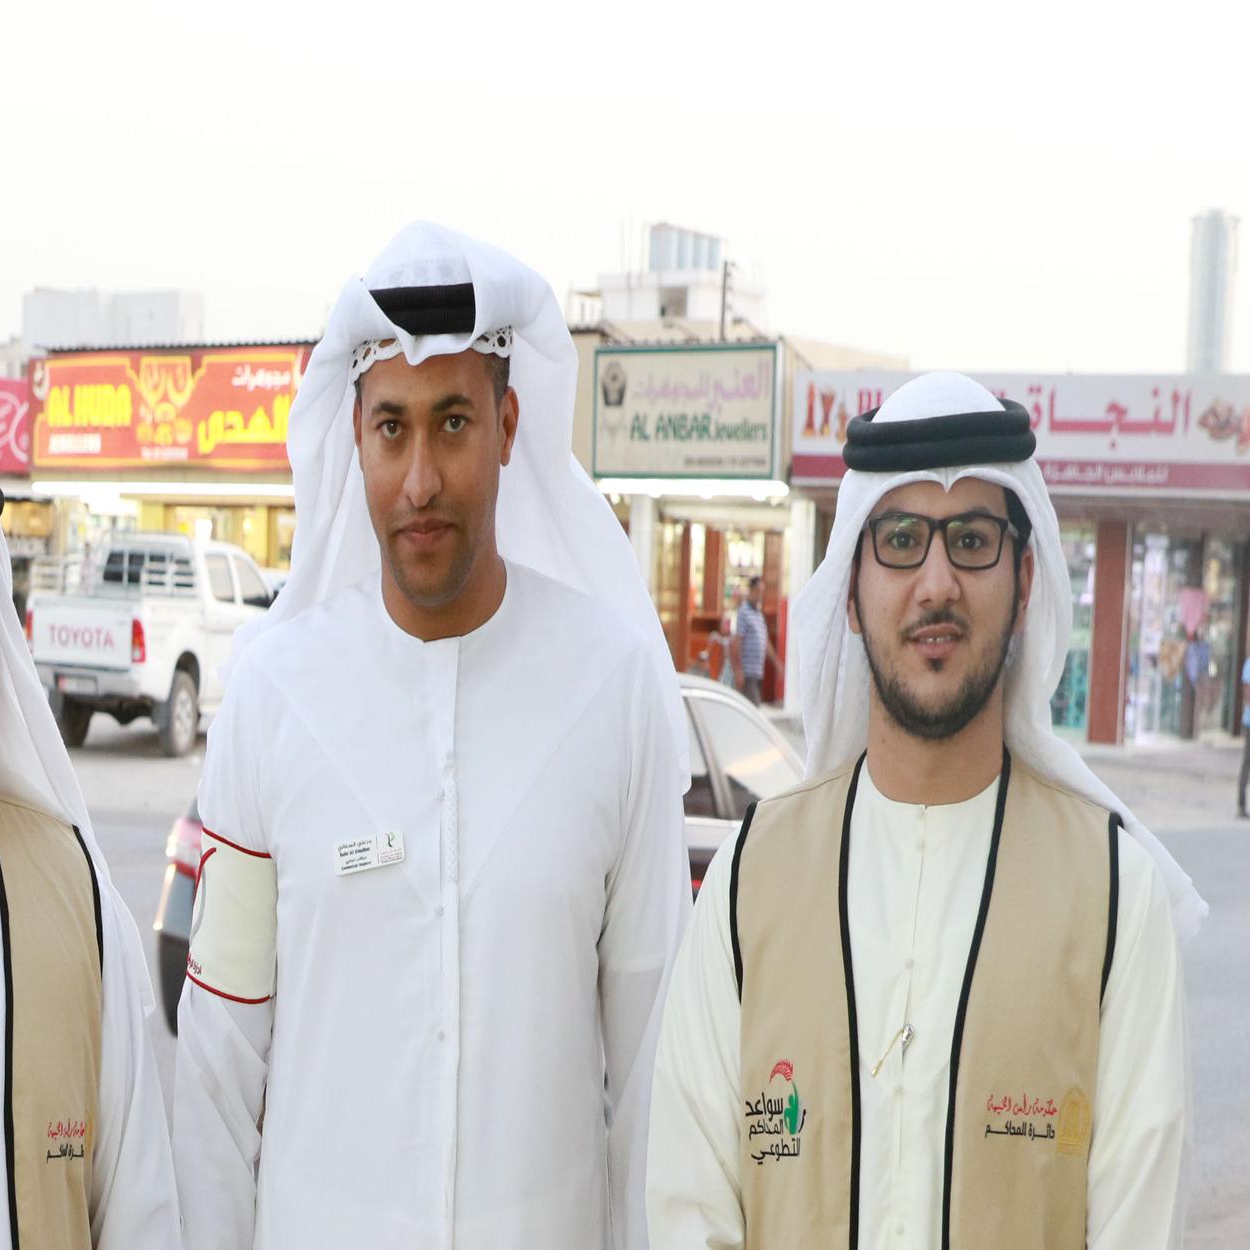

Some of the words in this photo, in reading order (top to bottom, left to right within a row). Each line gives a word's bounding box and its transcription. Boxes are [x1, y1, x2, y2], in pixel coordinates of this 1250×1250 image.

[48, 384, 72, 427] AL
[74, 383, 132, 428] HUDA
[630, 413, 649, 441] AL
[655, 413, 711, 441] ANBAR
[49, 624, 115, 649] TOYOTA
[745, 1091, 783, 1122] سواعد
[749, 1118, 783, 1141] المحاكم
[751, 1137, 800, 1165] التطوعي
